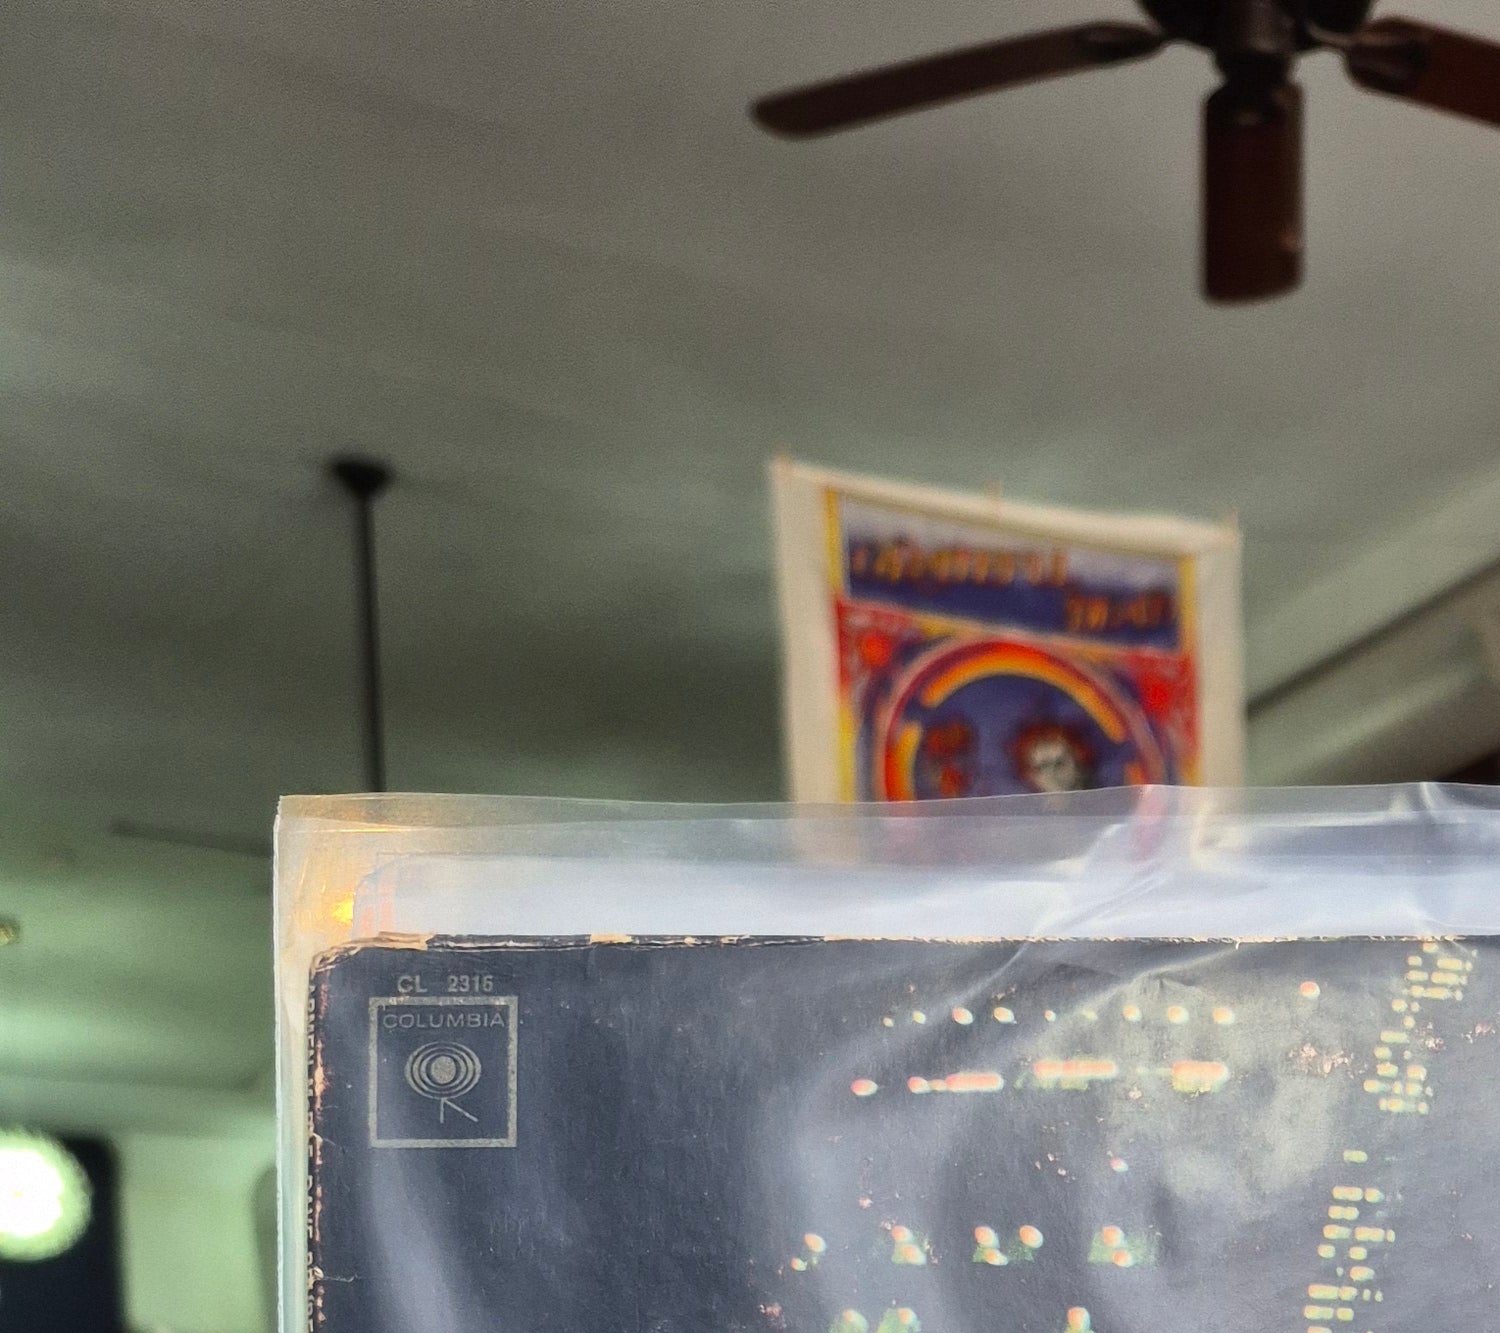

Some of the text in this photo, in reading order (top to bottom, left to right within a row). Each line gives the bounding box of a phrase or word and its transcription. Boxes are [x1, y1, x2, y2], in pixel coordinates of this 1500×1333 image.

[397, 974, 495, 993] CL 2316
[382, 1012, 506, 1029] COLUMBIA
